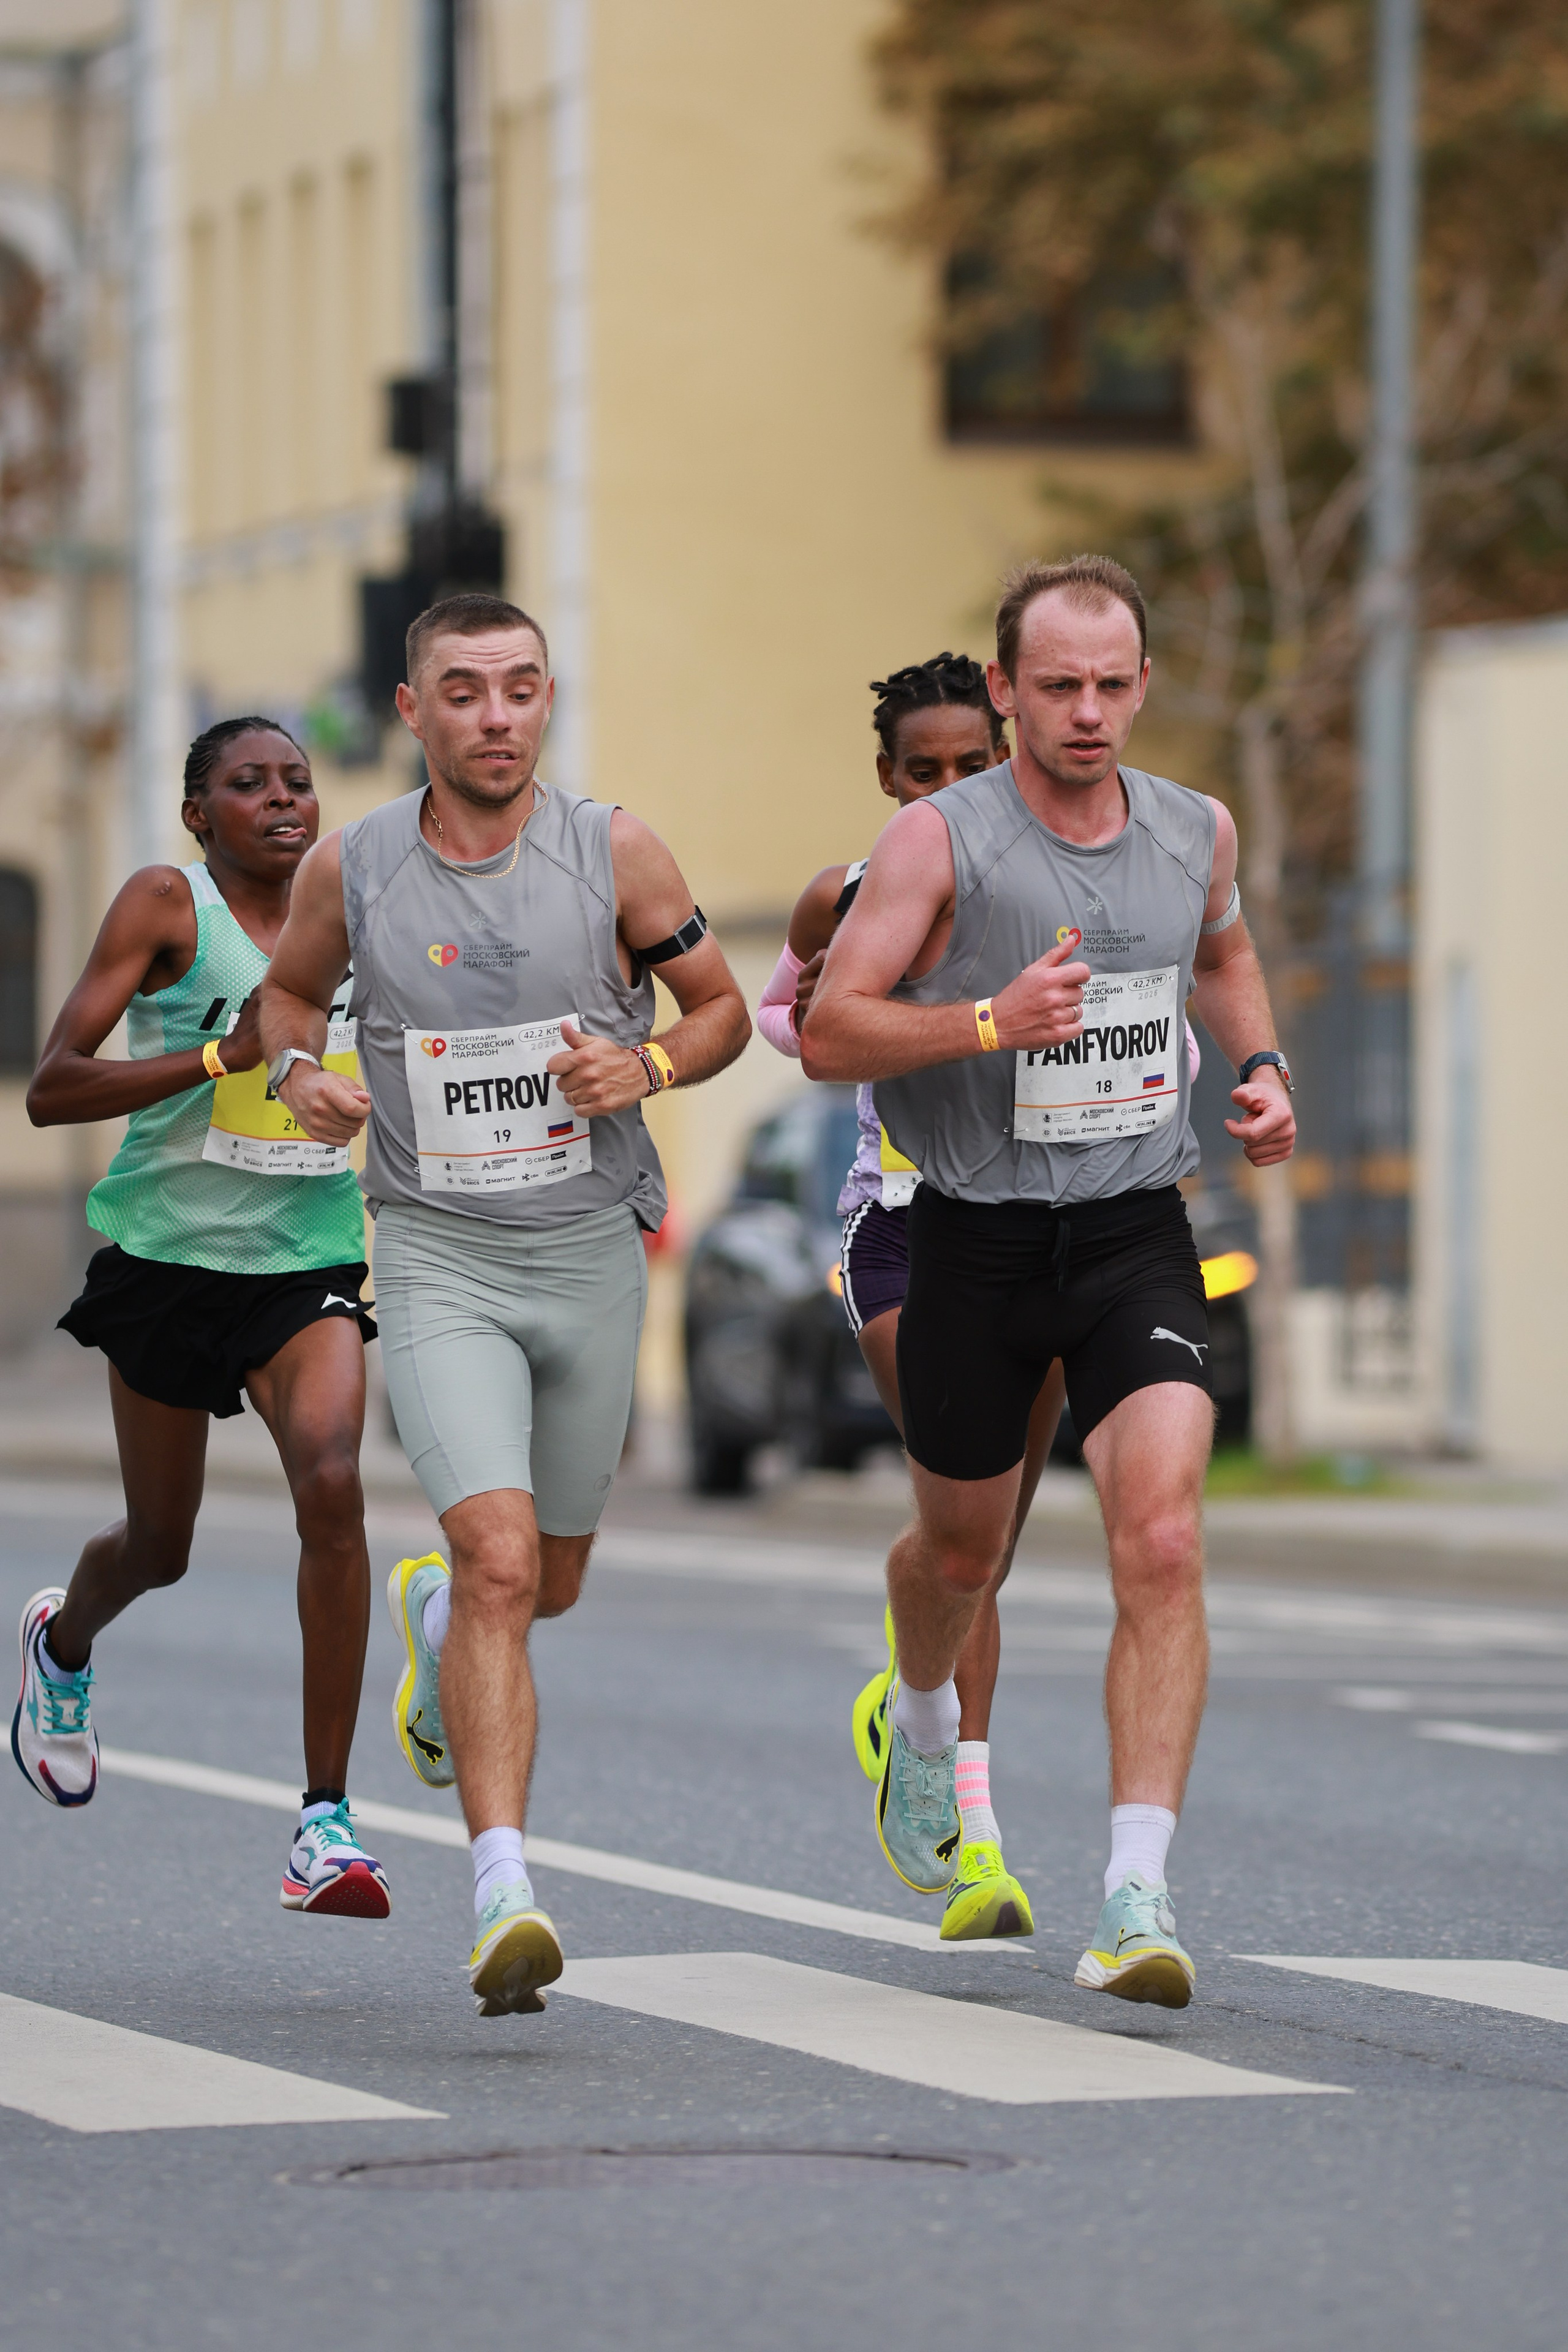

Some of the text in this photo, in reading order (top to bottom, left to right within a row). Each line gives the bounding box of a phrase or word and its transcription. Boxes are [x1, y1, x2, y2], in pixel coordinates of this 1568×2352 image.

[1084, 933, 1145, 945] МОСКОВСКИЙ
[464, 948, 530, 960] МОСКОВСКИЙ
[1084, 945, 1129, 954] МАРАФОН
[464, 960, 513, 968] МАРАФОН
[1133, 979, 1150, 989] 42,2
[1084, 985, 1123, 997] КОВСКИЙ
[334, 1029, 347, 1038] 42,2
[451, 1034, 497, 1042] СБЕРПРАЙМ
[524, 1030, 543, 1039] 42,2
[451, 1038, 514, 1050] МОСКОВСКИЙ
[452, 1049, 499, 1058] МАРАФОН
[1096, 1080, 1112, 1093] 18
[443, 1072, 550, 1115] PETROV
[284, 1118, 298, 1131] 21
[494, 1129, 511, 1143] 19
